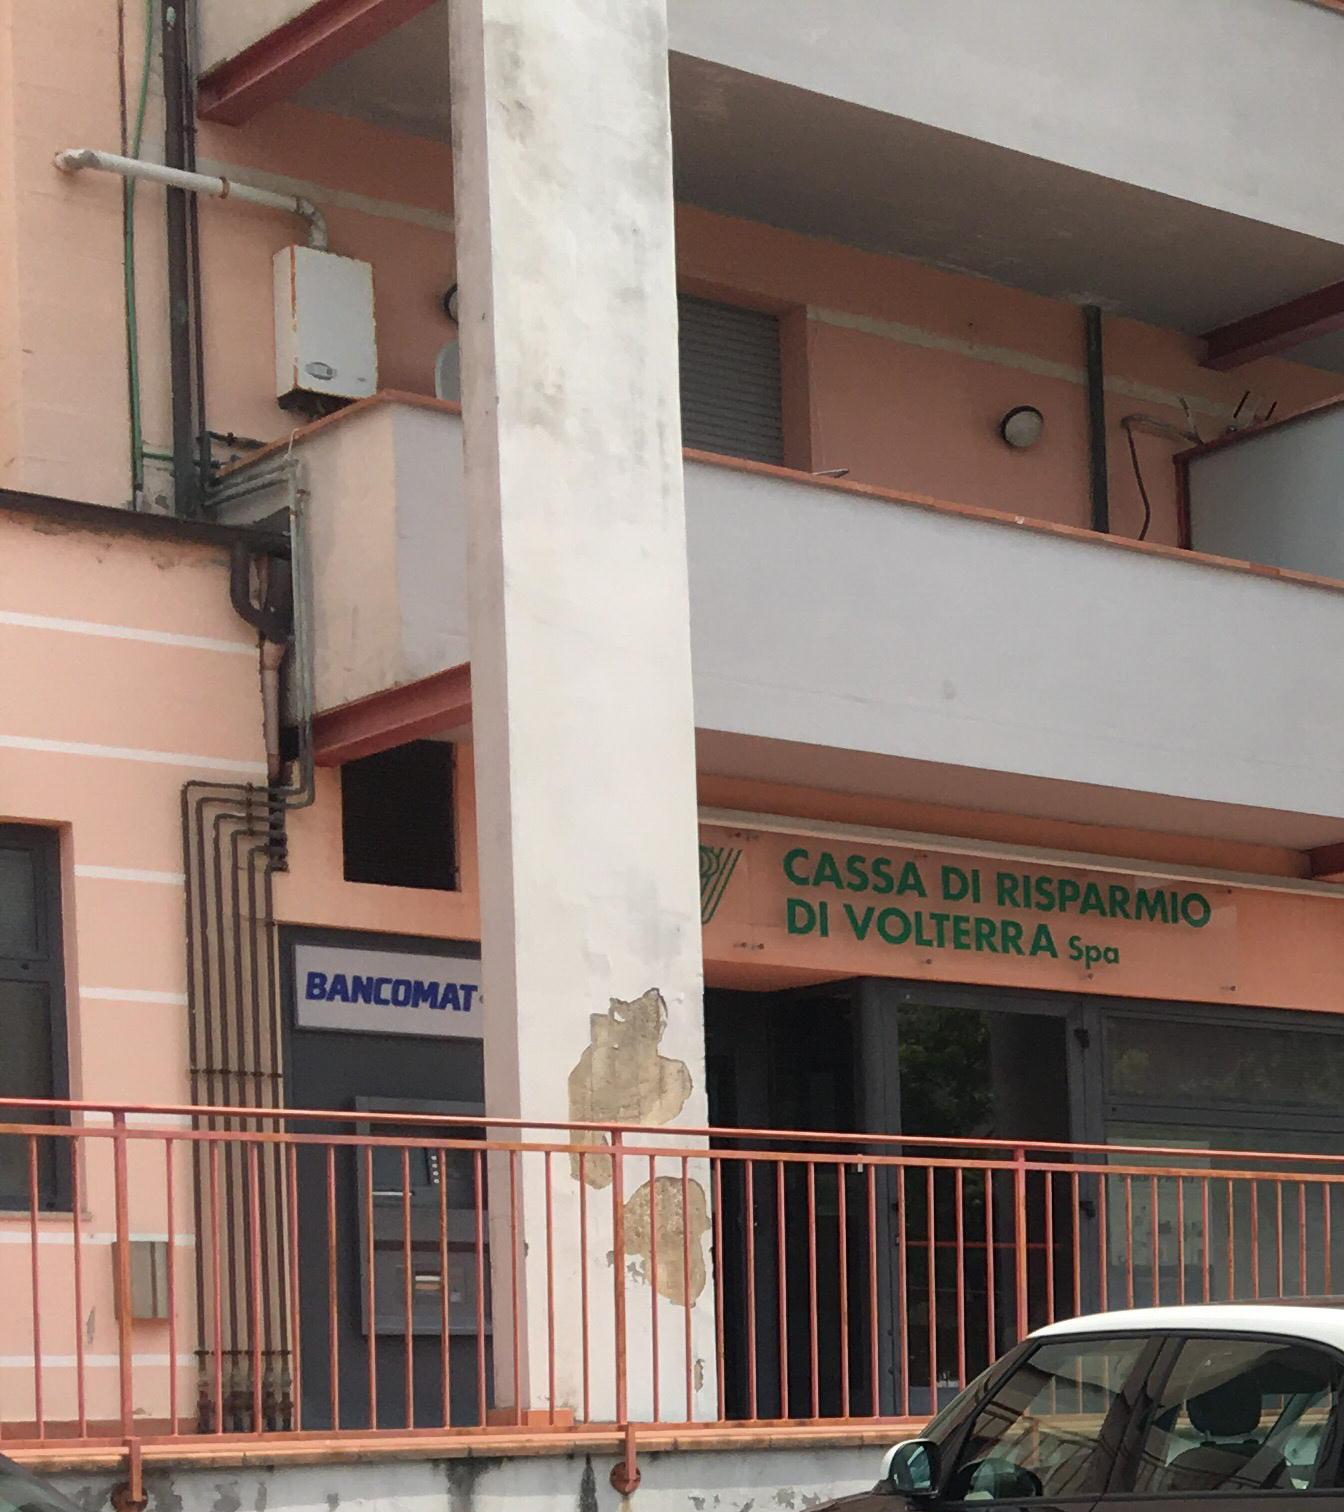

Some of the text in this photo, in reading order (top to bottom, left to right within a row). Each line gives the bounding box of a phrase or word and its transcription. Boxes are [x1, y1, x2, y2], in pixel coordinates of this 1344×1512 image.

[783, 848, 1211, 928] CASSA DI RISPARMIO
[787, 898, 1120, 969] DI VOLTERRA Spa
[305, 970, 479, 1013] BANCOMAT
